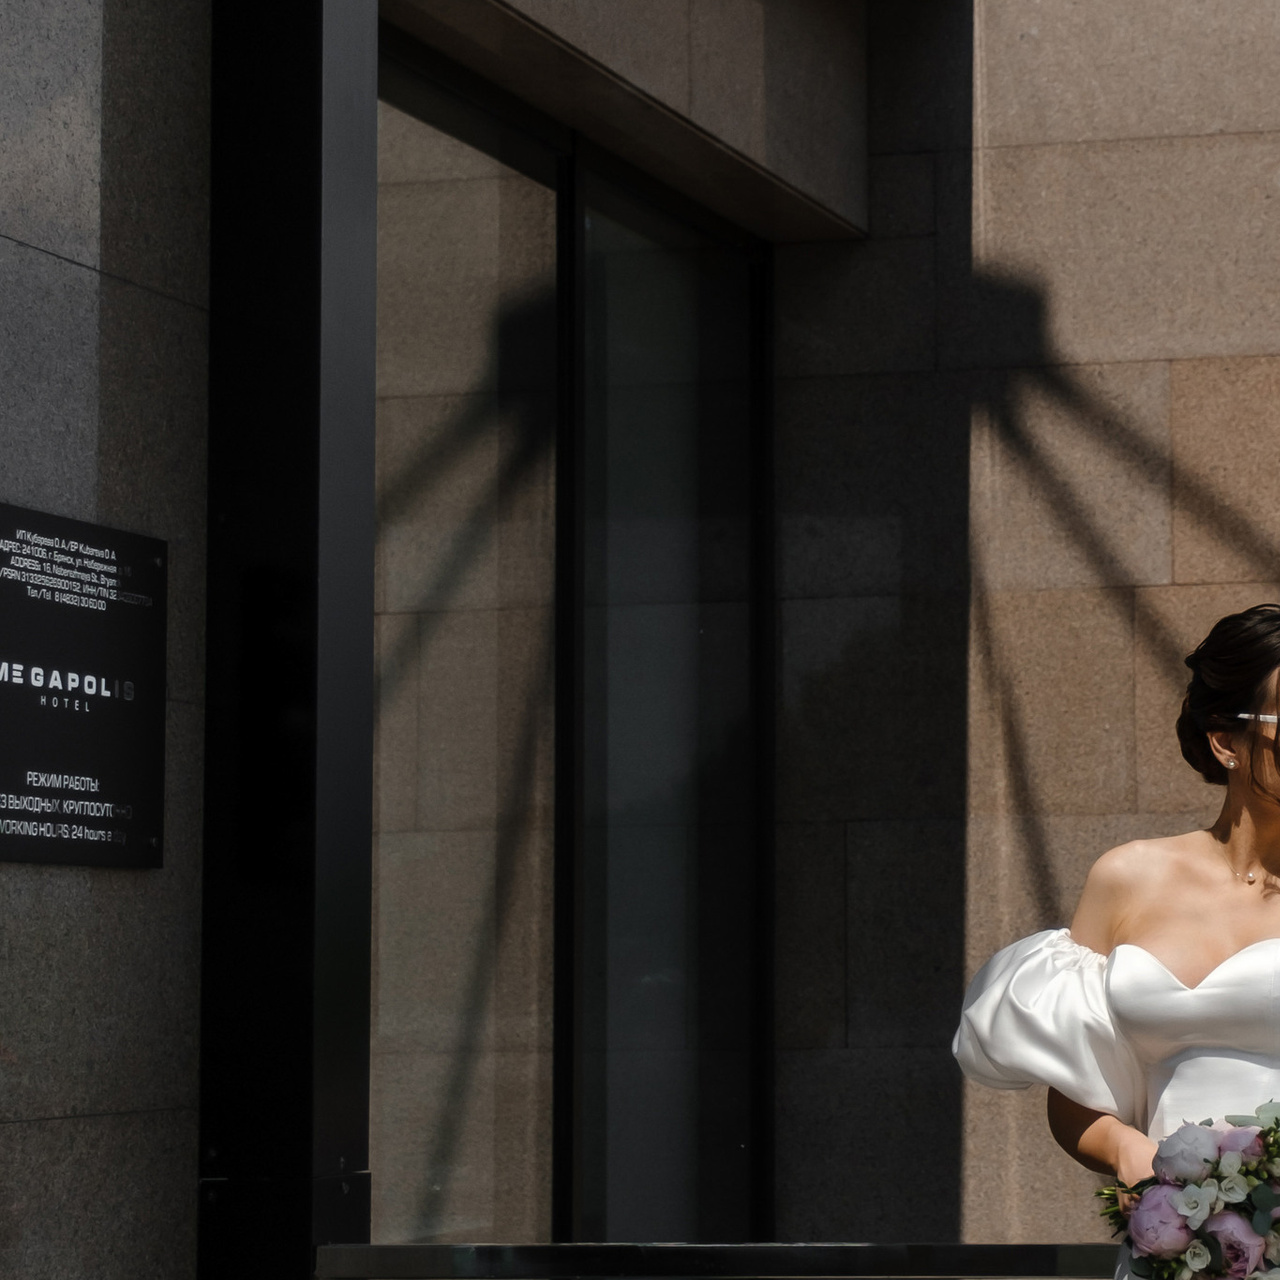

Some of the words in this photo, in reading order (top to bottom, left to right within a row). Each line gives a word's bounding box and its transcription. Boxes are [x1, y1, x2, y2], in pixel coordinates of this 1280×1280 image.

[54, 591, 59, 602] 8
[80, 597, 89, 608] 30
[98, 600, 106, 611] 00
[40, 695, 90, 712] HOTEL
[27, 772, 62, 788] РЕЖИМ
[63, 775, 100, 792] РАБОТЫ:
[71, 825, 83, 839] 24
[84, 826, 106, 841] hours
[107, 831, 112, 841] a
